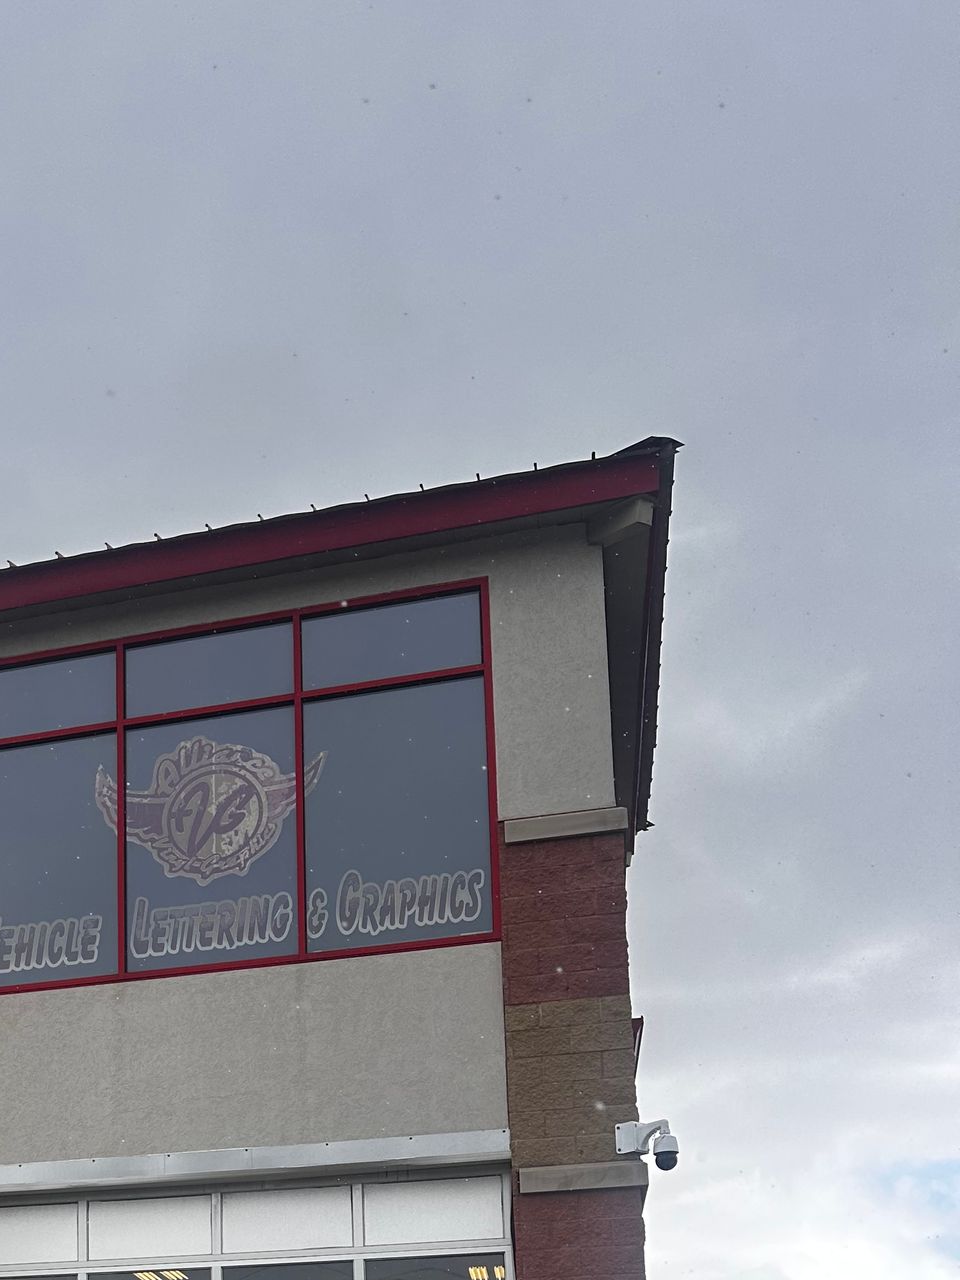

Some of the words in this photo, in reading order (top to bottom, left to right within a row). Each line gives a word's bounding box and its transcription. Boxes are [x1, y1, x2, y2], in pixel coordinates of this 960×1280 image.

[132, 893, 291, 957] LETTERING
[307, 890, 327, 937] &
[337, 870, 485, 936] GRAPHICS
